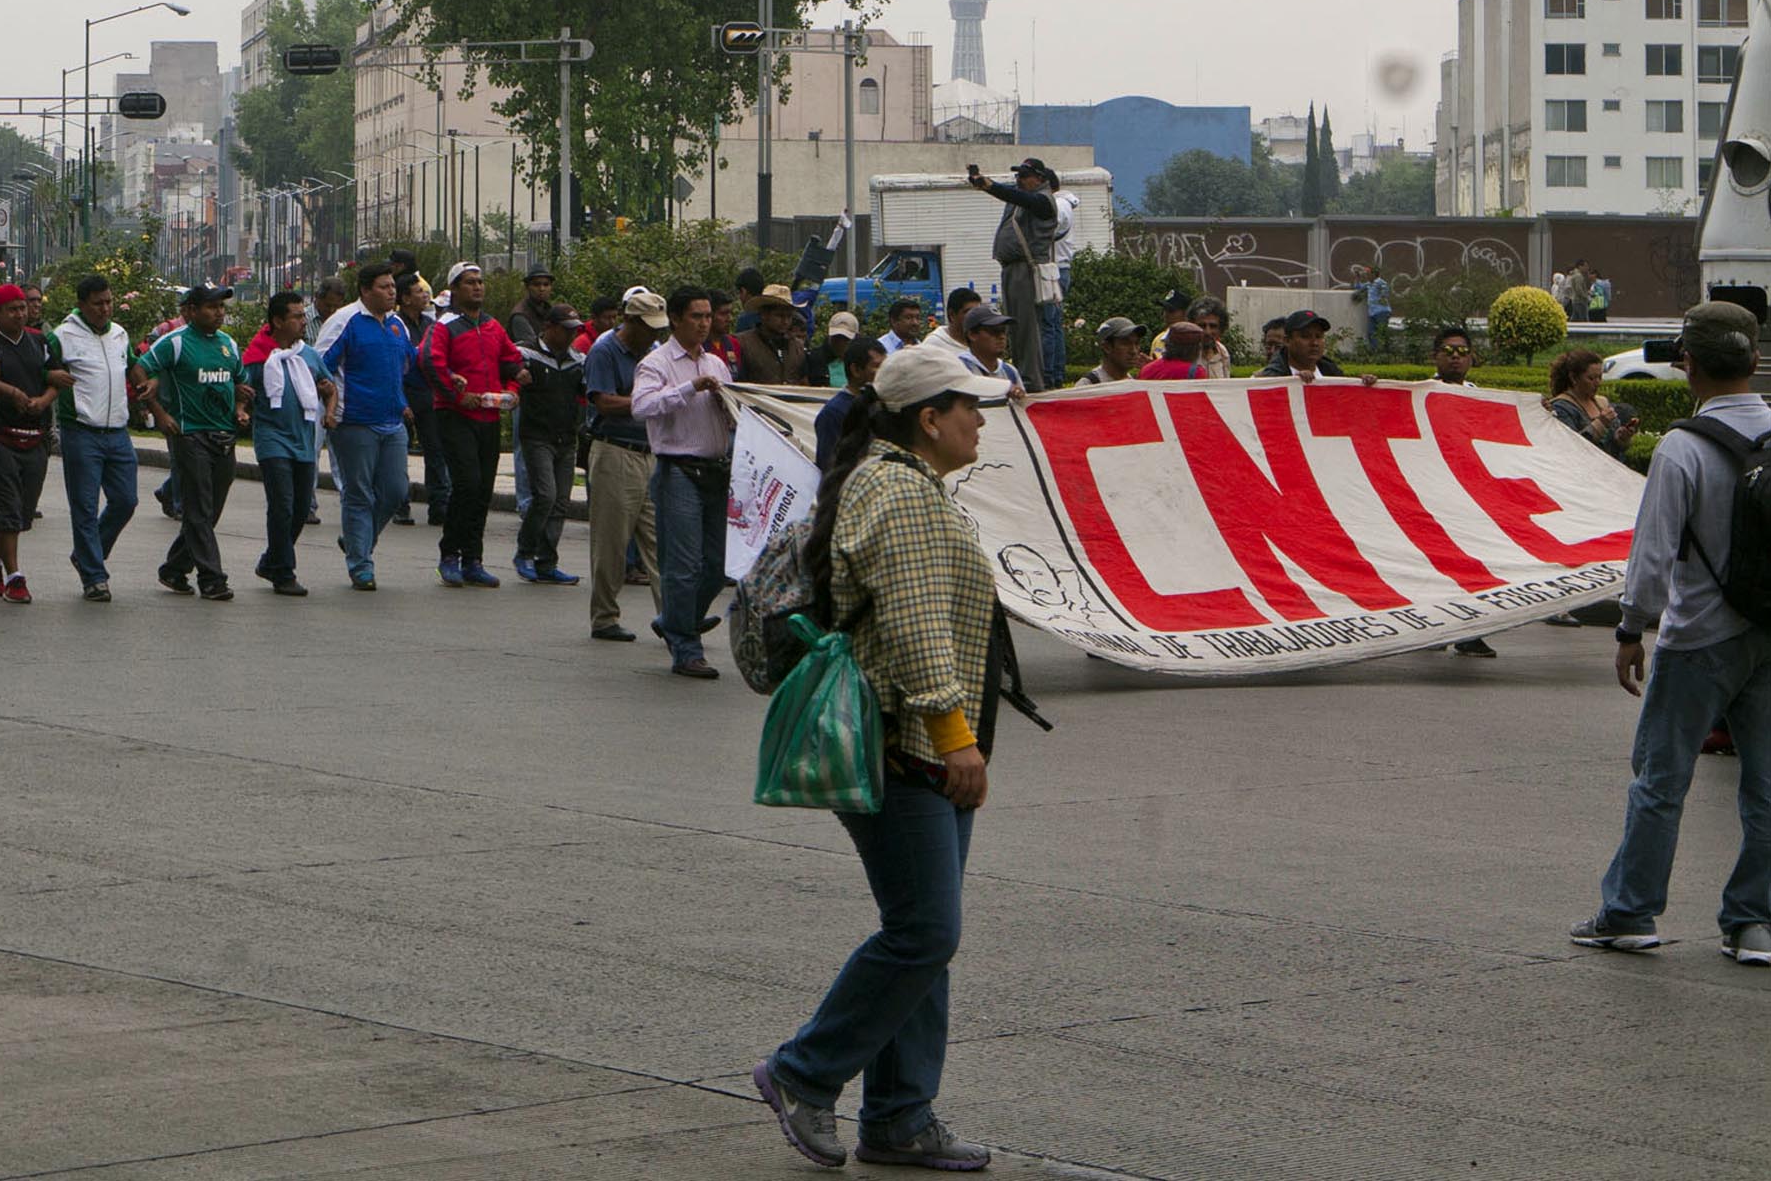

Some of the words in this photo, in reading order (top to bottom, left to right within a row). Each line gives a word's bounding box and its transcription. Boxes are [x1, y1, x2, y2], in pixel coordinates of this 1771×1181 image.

[198, 368, 231, 383] bwin
[1026, 384, 1634, 632] CNTE
[1149, 624, 1204, 659] DE
[1193, 616, 1399, 659] TRABAJADORES
[1387, 608, 1445, 630] DE
[1433, 602, 1483, 621] LA
